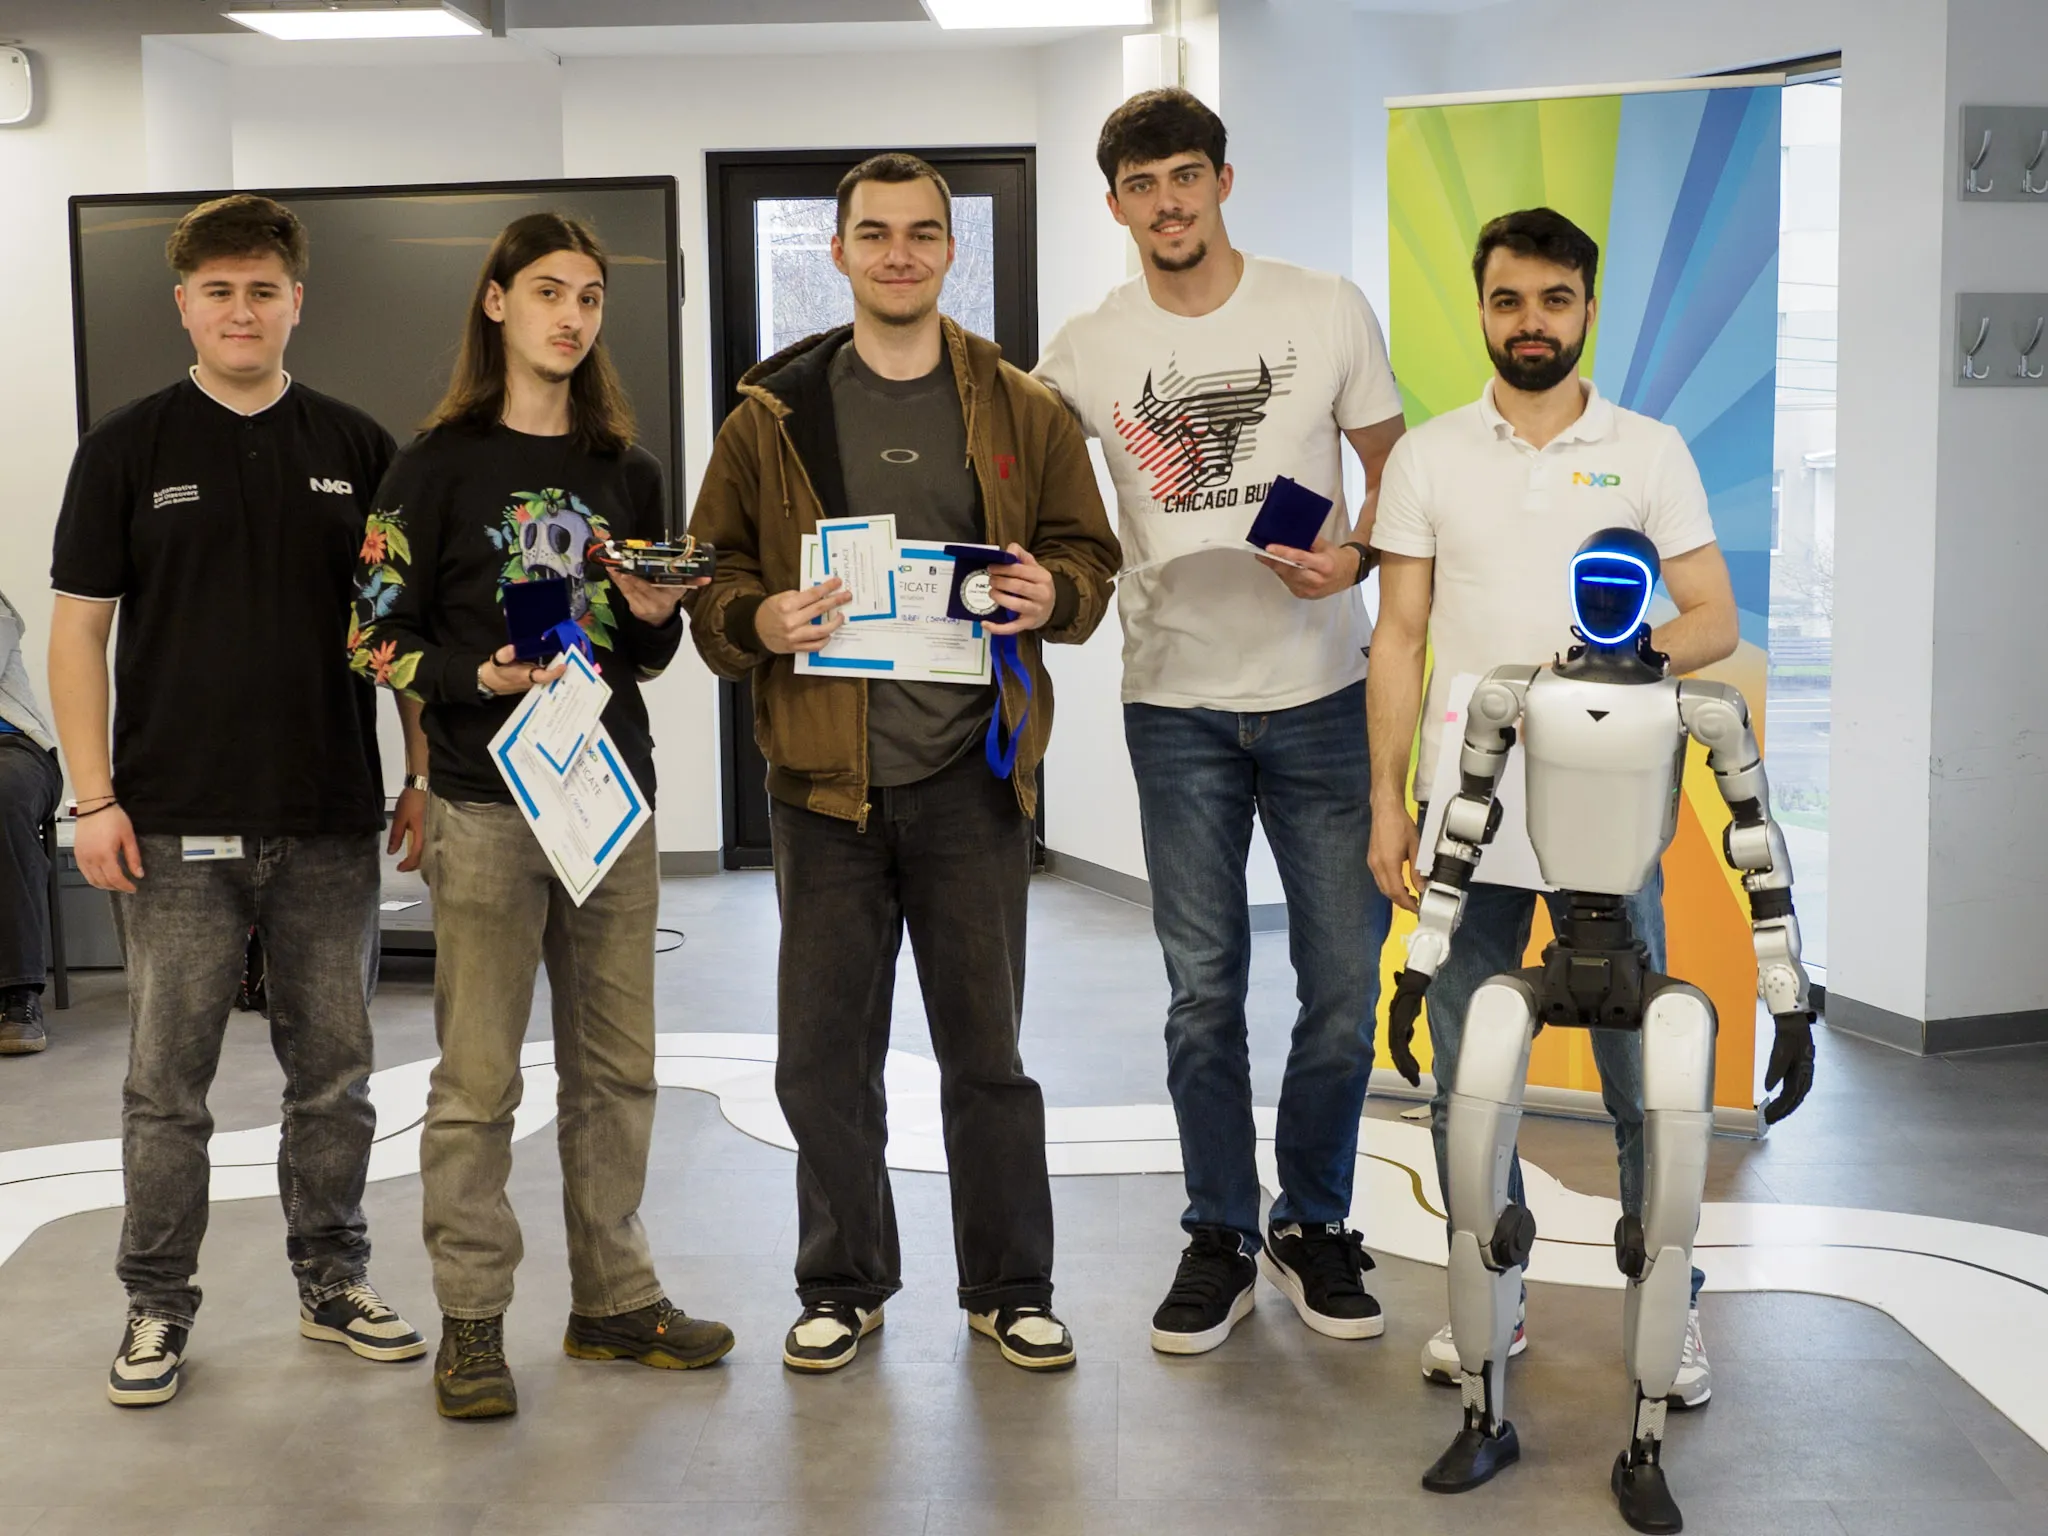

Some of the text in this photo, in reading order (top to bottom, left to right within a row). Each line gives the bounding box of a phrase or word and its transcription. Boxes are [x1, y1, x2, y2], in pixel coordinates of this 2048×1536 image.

[309, 477, 353, 495] NXP
[1572, 471, 1621, 487] NXP
[153, 484, 198, 498] Automotive
[1164, 488, 1238, 513] CHICAGO
